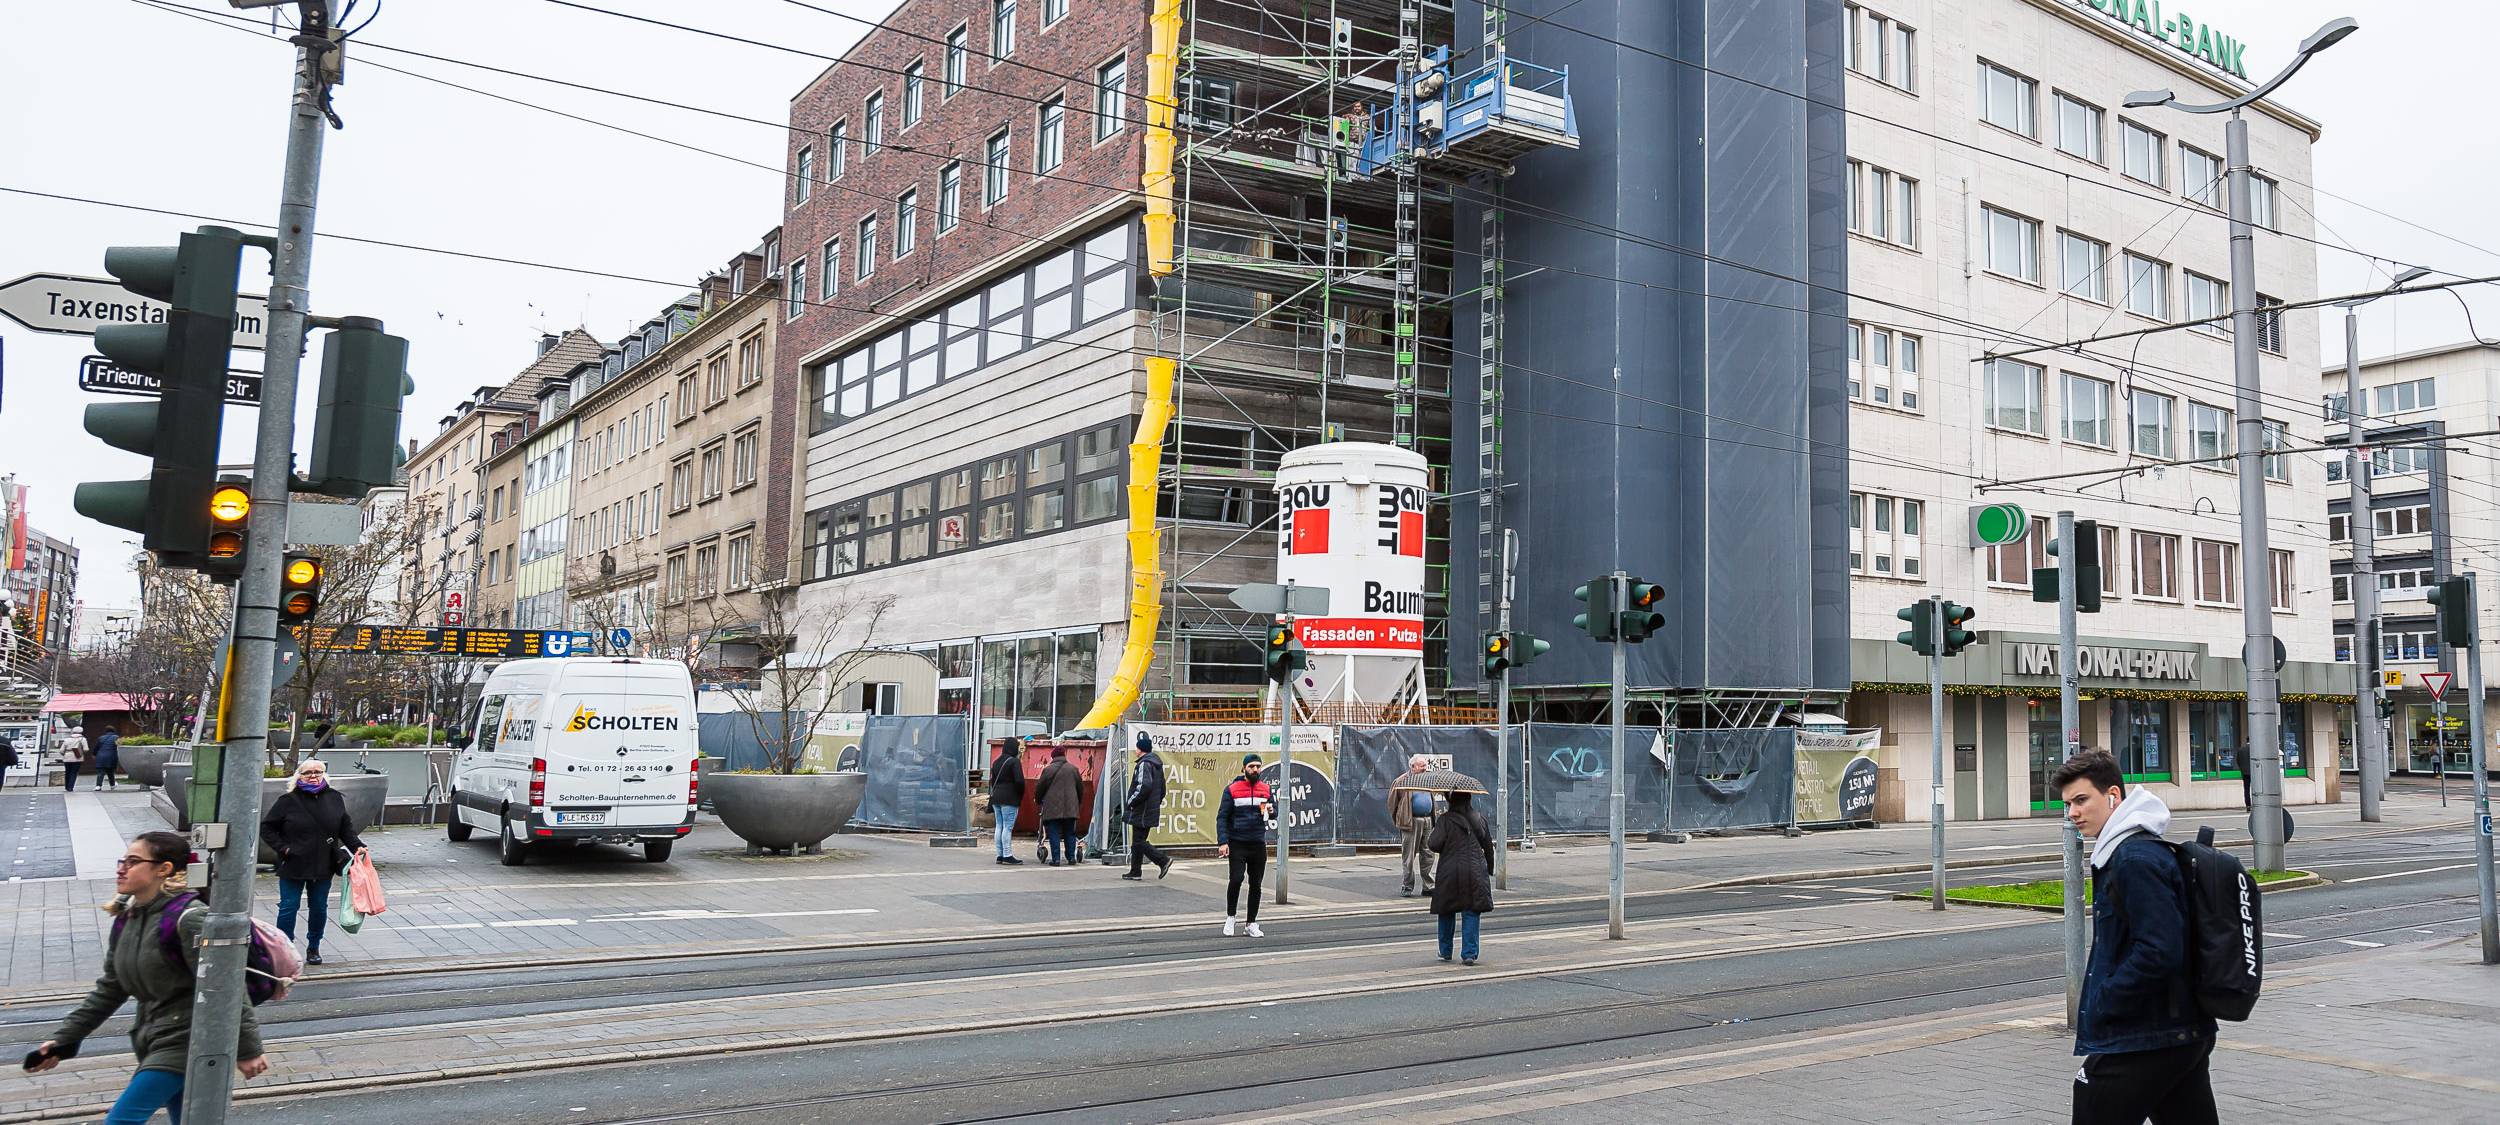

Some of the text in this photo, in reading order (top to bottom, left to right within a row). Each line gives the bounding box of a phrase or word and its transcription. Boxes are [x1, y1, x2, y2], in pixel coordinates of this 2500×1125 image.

[2088, 0, 2247, 79] NAL-BANK
[47, 292, 171, 324] Taxensta
[226, 379, 254, 398] Str.
[1302, 626, 1418, 643] Fassaden Putze
[2016, 643, 2198, 680] NATONAL-BANK
[573, 715, 678, 731] SCHOLTEN
[1178, 733, 1195, 746] 52
[1197, 733, 1214, 746] 00
[1216, 733, 1231, 746] 11
[1235, 733, 1251, 746] 15
[1162, 765, 1195, 784] TAIL
[559, 793, 677, 802] Scholten-Bauunternehmen.de
[1161, 789, 1206, 809] STRO
[563, 813, 604, 822] KLE MS 817
[1156, 814, 1199, 834] FICE
[2238, 872, 2257, 977] NIKE PRO
